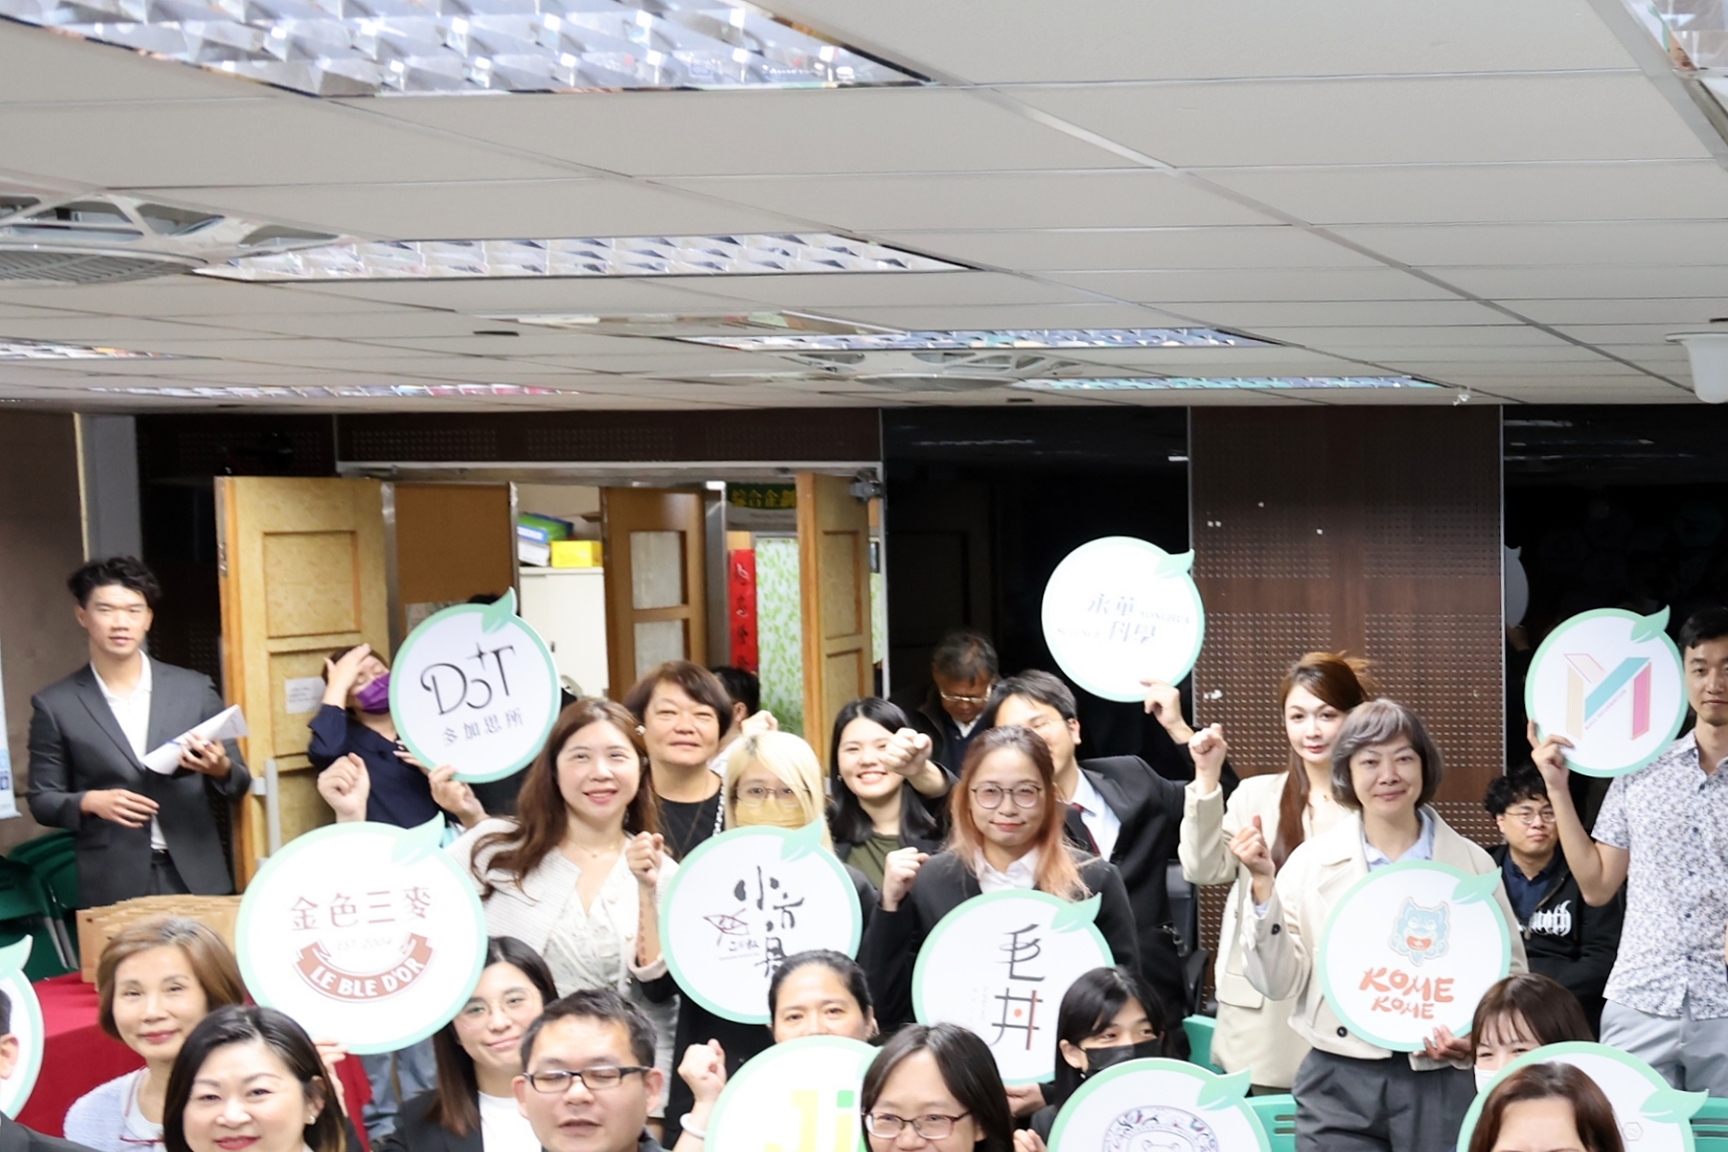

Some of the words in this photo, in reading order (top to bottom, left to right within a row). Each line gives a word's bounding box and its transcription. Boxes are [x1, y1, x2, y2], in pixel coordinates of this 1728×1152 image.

[291, 886, 431, 931] 金色三麥
[310, 964, 338, 990] LE
[336, 977, 379, 998] BLE
[1359, 966, 1456, 1004] KOME
[1371, 995, 1435, 1020] KOME
